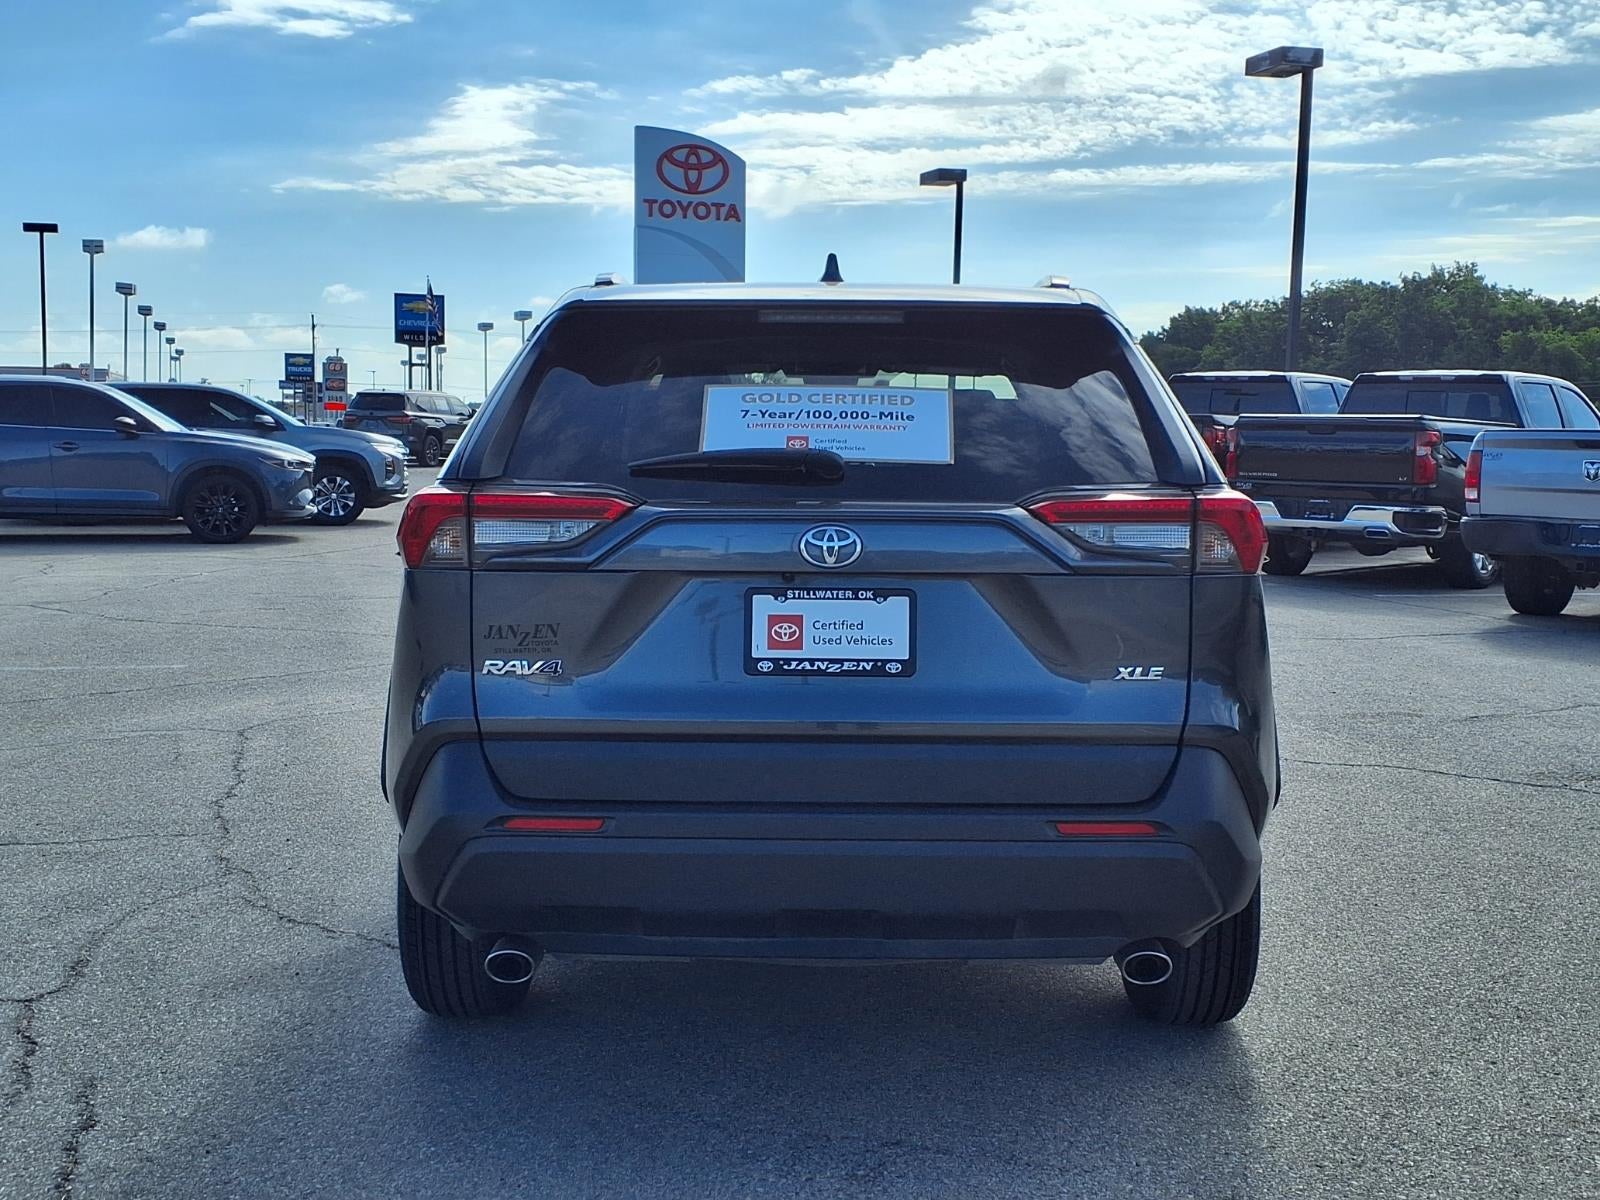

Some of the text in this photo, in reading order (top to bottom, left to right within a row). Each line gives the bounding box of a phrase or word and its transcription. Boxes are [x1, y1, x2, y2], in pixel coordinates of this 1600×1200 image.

[642, 198, 741, 223] TOYOTA
[741, 392, 916, 406] GOLD CERTIFIED
[740, 408, 916, 423] 7-Year/100,000-Mile
[746, 422, 908, 432] LIMITED POWERTRAIN WARRANTY
[858, 590, 874, 599] OK
[812, 619, 865, 631] Certified
[484, 623, 560, 647] JANZEN
[812, 635, 894, 646] Used Vehicles
[482, 659, 563, 676] RAV4
[783, 661, 875, 673] JANZEN
[1112, 666, 1165, 681] XLE
